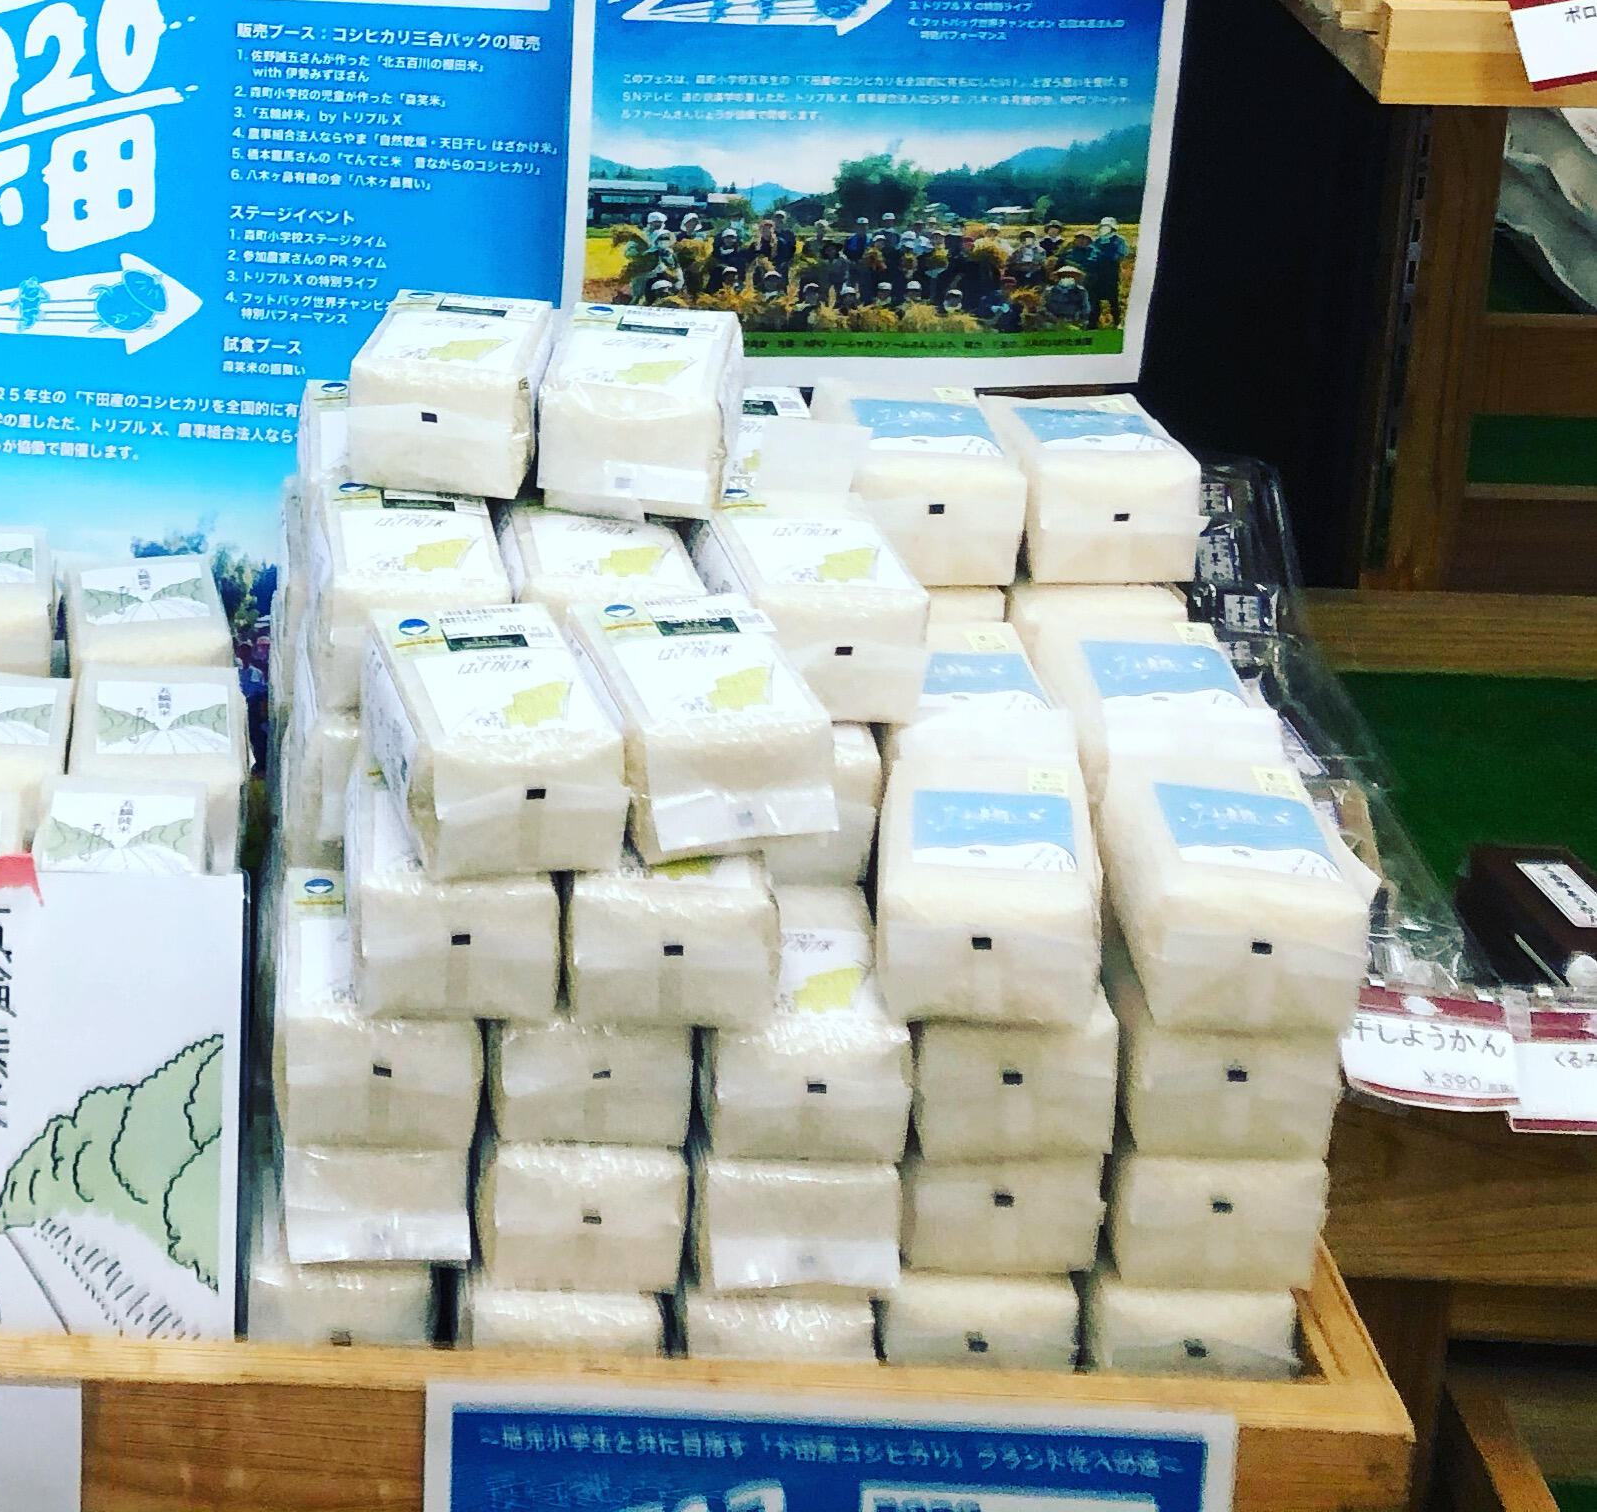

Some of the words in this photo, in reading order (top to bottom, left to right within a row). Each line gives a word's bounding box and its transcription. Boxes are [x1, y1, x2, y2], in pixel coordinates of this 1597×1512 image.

[253, 67, 282, 79] with
[319, 110, 335, 126] by
[392, 114, 402, 125] X
[229, 205, 354, 226] ステージイベント
[329, 254, 348, 267] PR
[352, 255, 386, 270] タイム
[293, 274, 303, 286] X
[223, 336, 302, 355] 試食ブース
